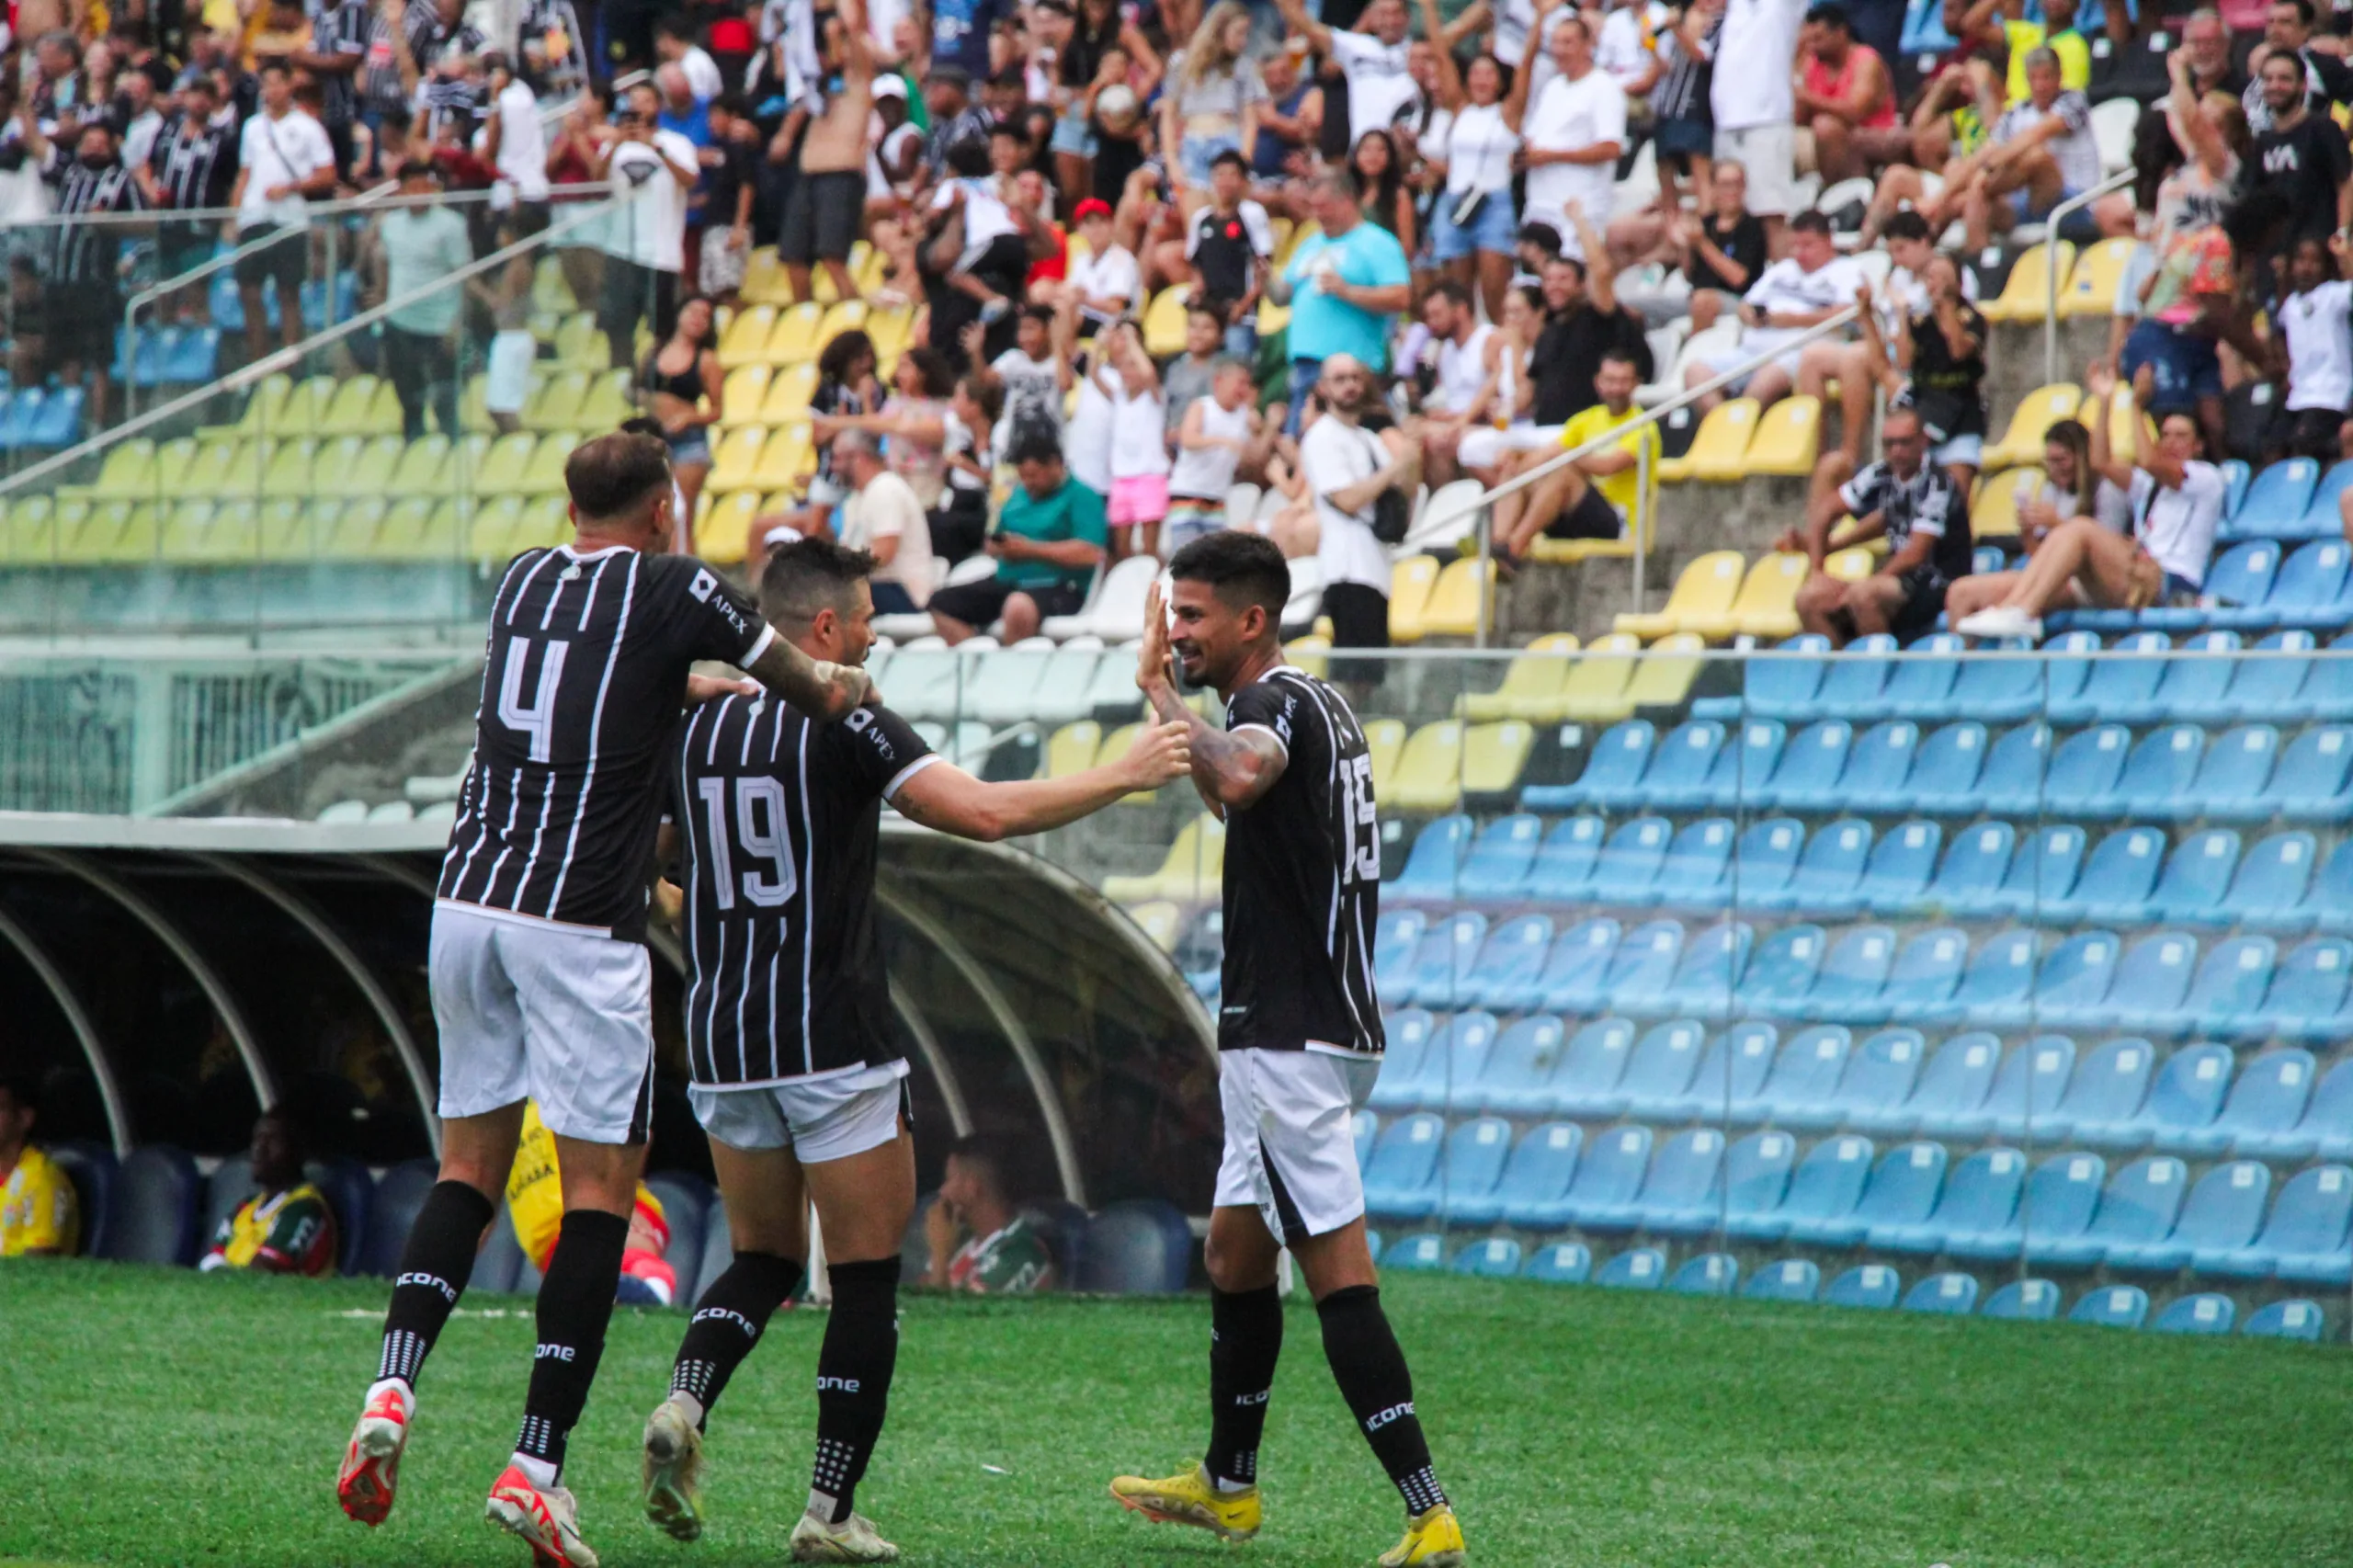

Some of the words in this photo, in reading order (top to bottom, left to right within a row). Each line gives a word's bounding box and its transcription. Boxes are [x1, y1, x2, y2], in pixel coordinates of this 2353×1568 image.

[711, 595, 747, 634] APEX
[497, 636, 569, 764] 4
[699, 776, 797, 910] 19
[1339, 753, 1381, 885] 15
